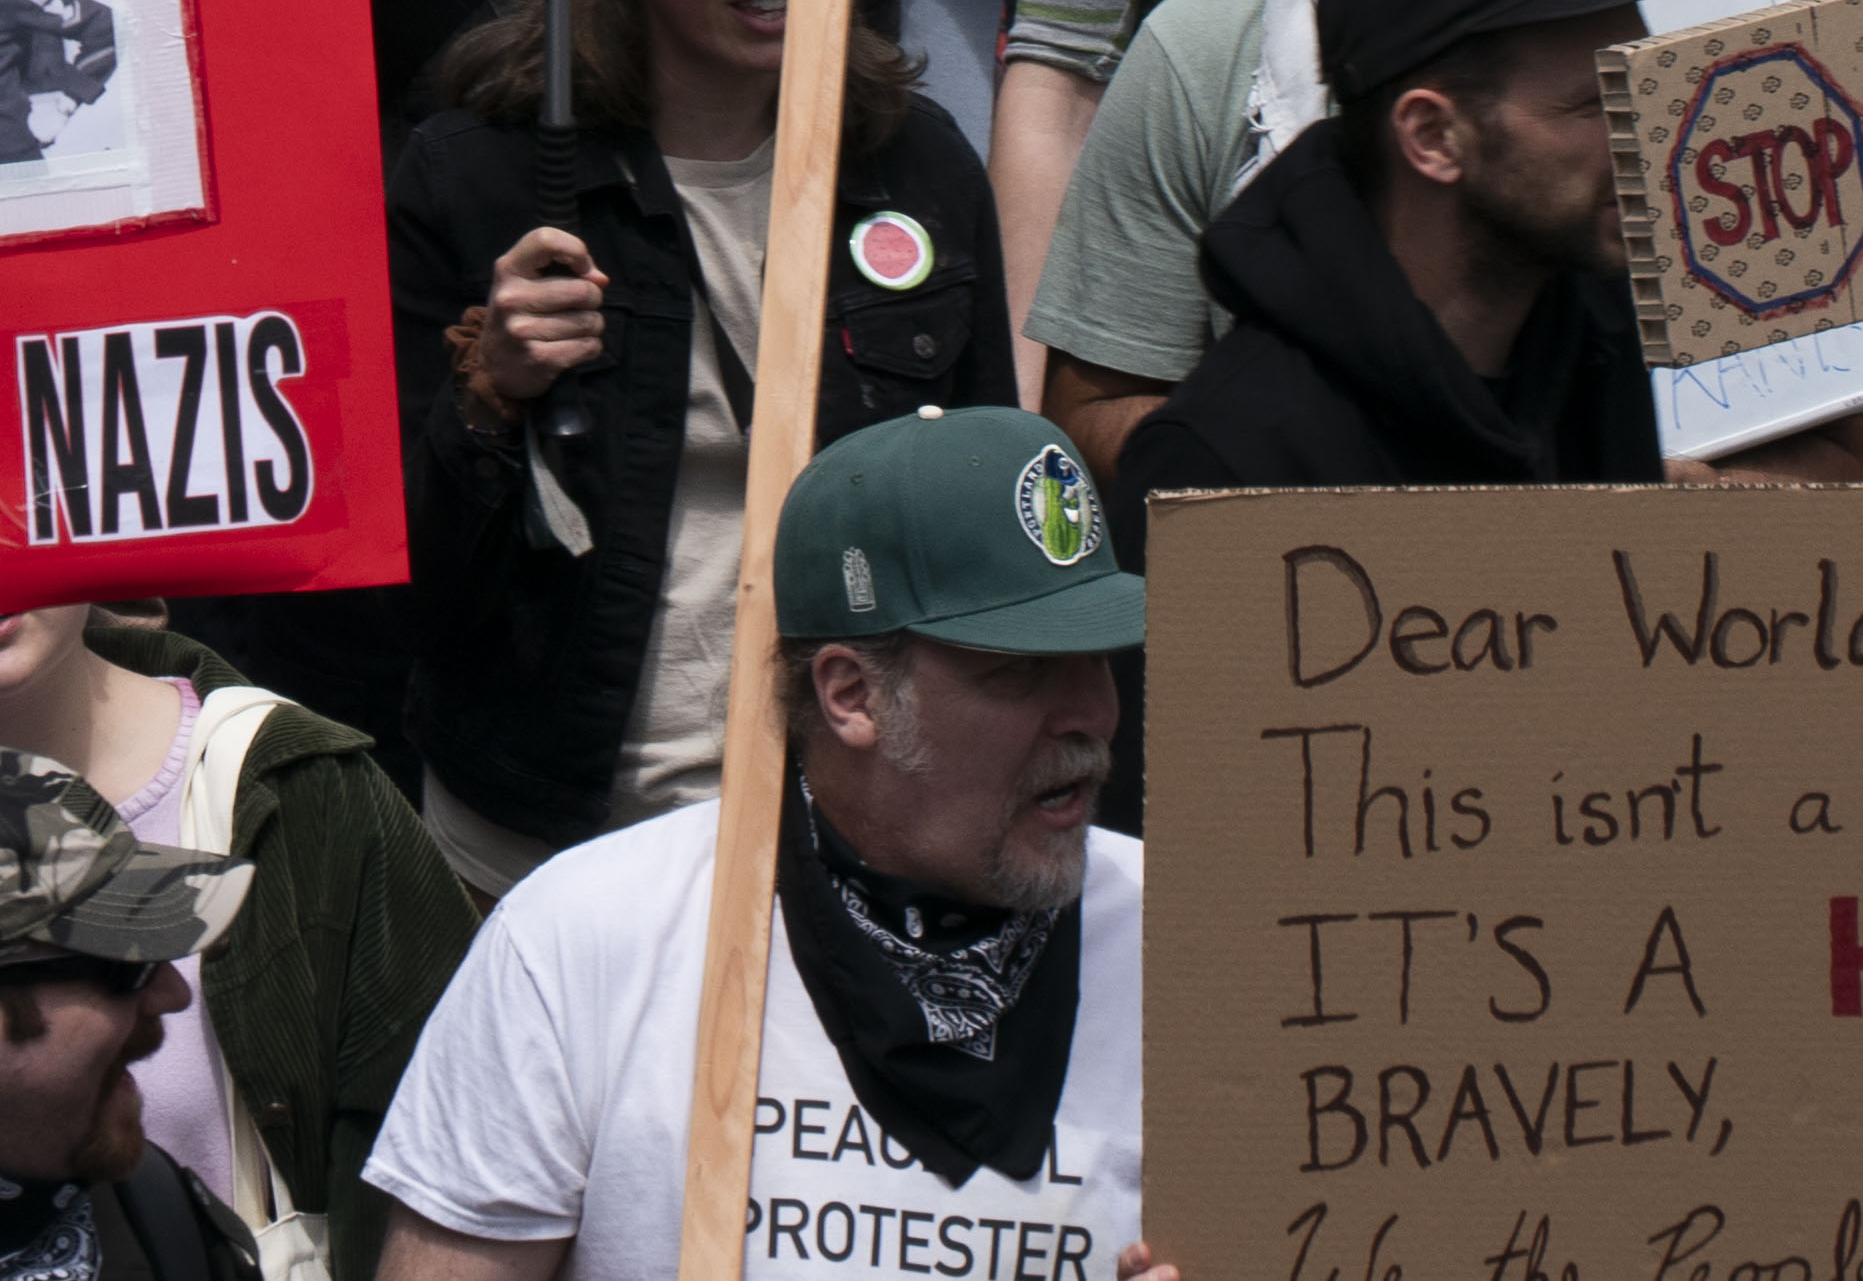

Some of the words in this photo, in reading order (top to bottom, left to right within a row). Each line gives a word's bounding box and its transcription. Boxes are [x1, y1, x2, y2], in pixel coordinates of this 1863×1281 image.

[1695, 115, 1855, 247] STOP
[20, 315, 310, 540] NAZIS
[1281, 544, 1557, 689] Dear
[1262, 723, 1493, 859] This
[1788, 782, 1842, 834] a
[1279, 910, 1550, 1029] IT'S
[1626, 905, 1707, 1019] A
[1298, 1057, 1734, 1173] BRAVELY,
[745, 1197, 1093, 1281] PROTESTER
